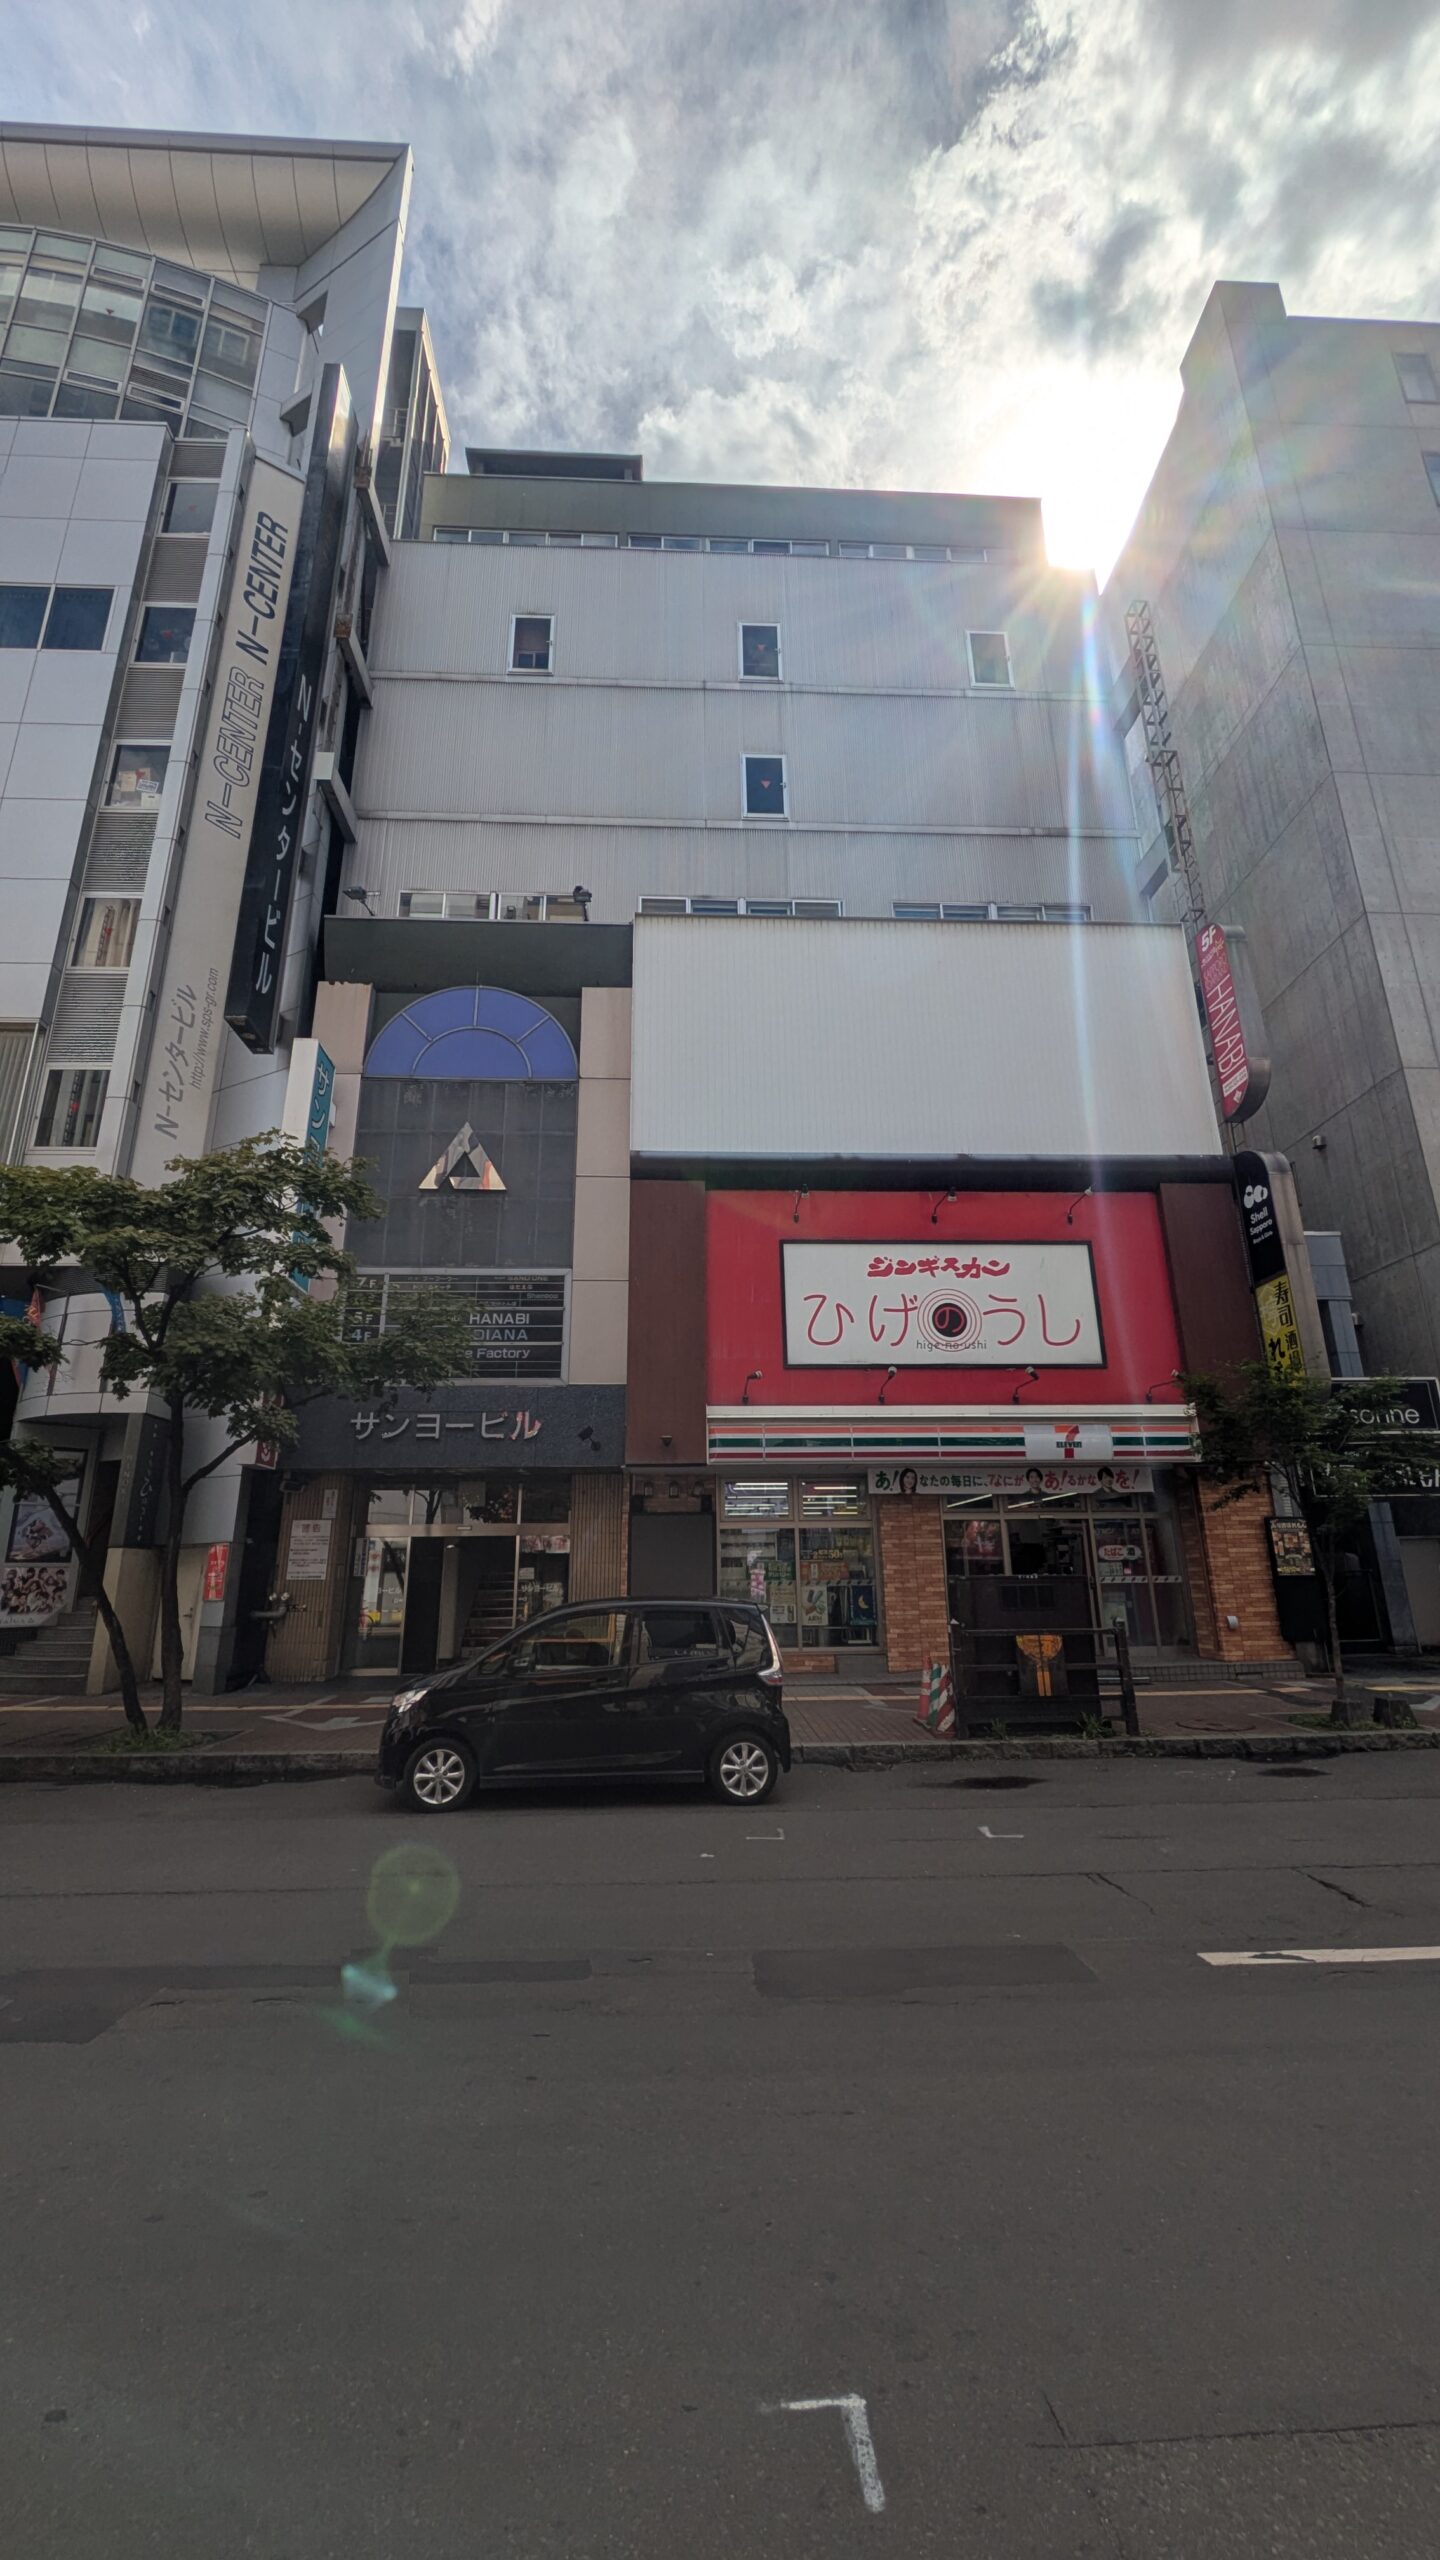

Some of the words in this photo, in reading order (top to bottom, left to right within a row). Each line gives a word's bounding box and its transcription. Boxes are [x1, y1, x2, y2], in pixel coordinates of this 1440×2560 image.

[255, 673, 312, 994] N-センタービル
[1201, 924, 1217, 952] 5F
[1206, 973, 1247, 1079] HANABI
[1249, 1219, 1273, 1236] Sapporo
[1250, 1205, 1269, 1225] Shell
[867, 1256, 1011, 1279] ジンギスカン
[469, 1312, 530, 1325] HANABI
[804, 1293, 1081, 1346] ひげのうし
[476, 1347, 531, 1360] Factory
[350, 1409, 542, 1440] サンヨービル
